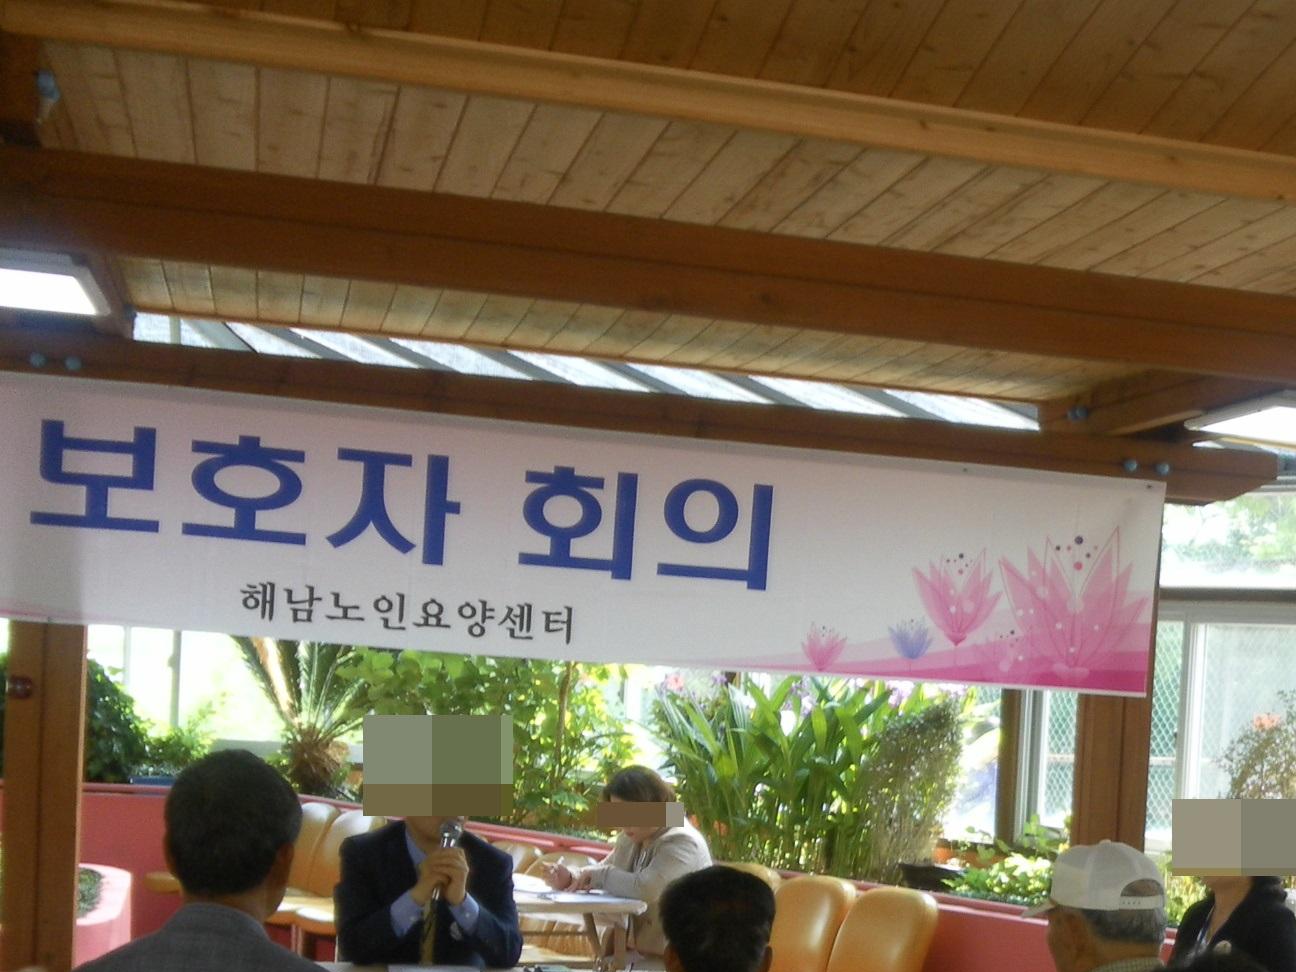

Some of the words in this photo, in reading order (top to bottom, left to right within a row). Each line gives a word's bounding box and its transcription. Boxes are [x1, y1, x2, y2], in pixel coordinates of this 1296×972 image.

[29, 418, 461, 567] 보호자
[517, 465, 777, 592] 회의
[239, 581, 575, 646] 해남노인요양센터
